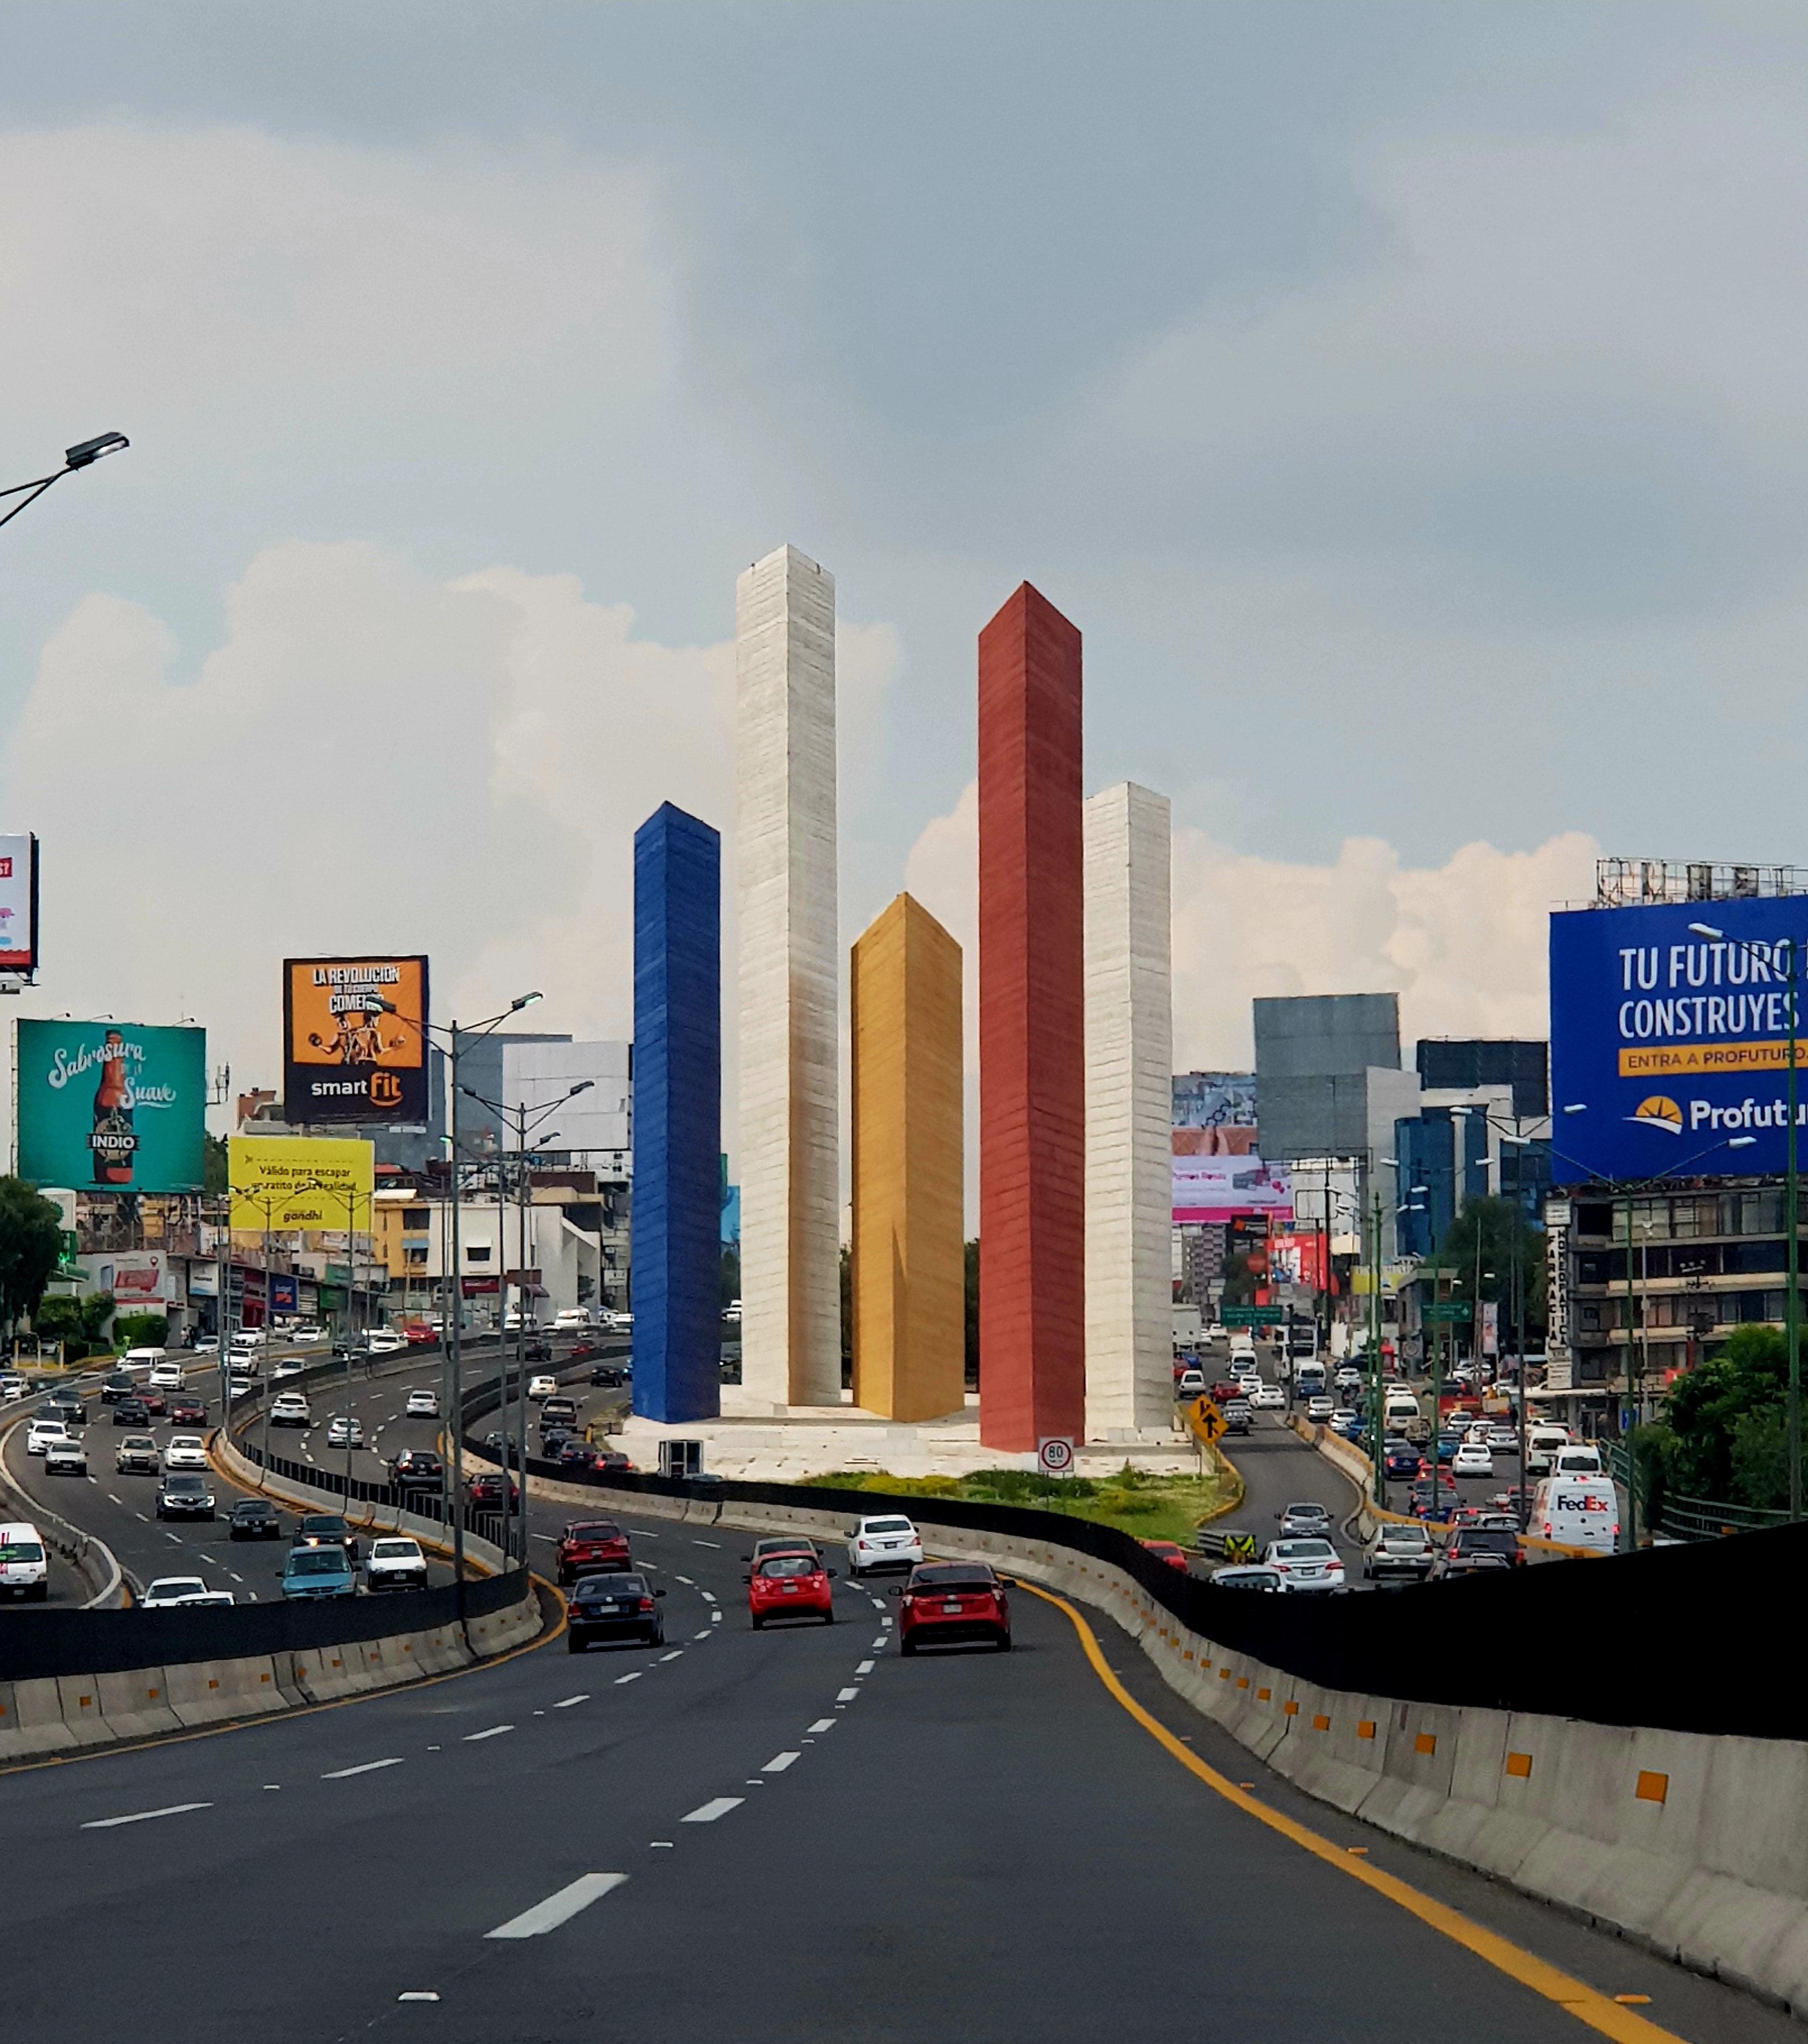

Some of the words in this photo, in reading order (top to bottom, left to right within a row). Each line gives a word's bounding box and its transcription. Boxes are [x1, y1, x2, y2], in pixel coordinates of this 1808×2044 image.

[1619, 947, 1658, 990] TU
[1669, 938, 1791, 988] FUTURO
[313, 968, 327, 984] LA
[1619, 992, 1799, 1038] CONSTRUYES
[48, 1042, 146, 1088] Sabrosura
[1628, 1054, 1682, 1068] ENTRA
[1687, 1053, 1698, 1065] A
[118, 1076, 176, 1109] Suave
[311, 1080, 368, 1096] smart
[371, 1072, 402, 1098] fit
[1690, 1098, 1808, 1130] Profutu
[92, 1135, 135, 1150] INDIO
[259, 1165, 289, 1176] Válido
[292, 1167, 313, 1178] para
[315, 1169, 351, 1178] escapar
[283, 1210, 322, 1223] gandhi
[1548, 1235, 1557, 1341] FARMACIA
[1049, 1445, 1063, 1458] 80
[1557, 1495, 1609, 1512] FedEx
